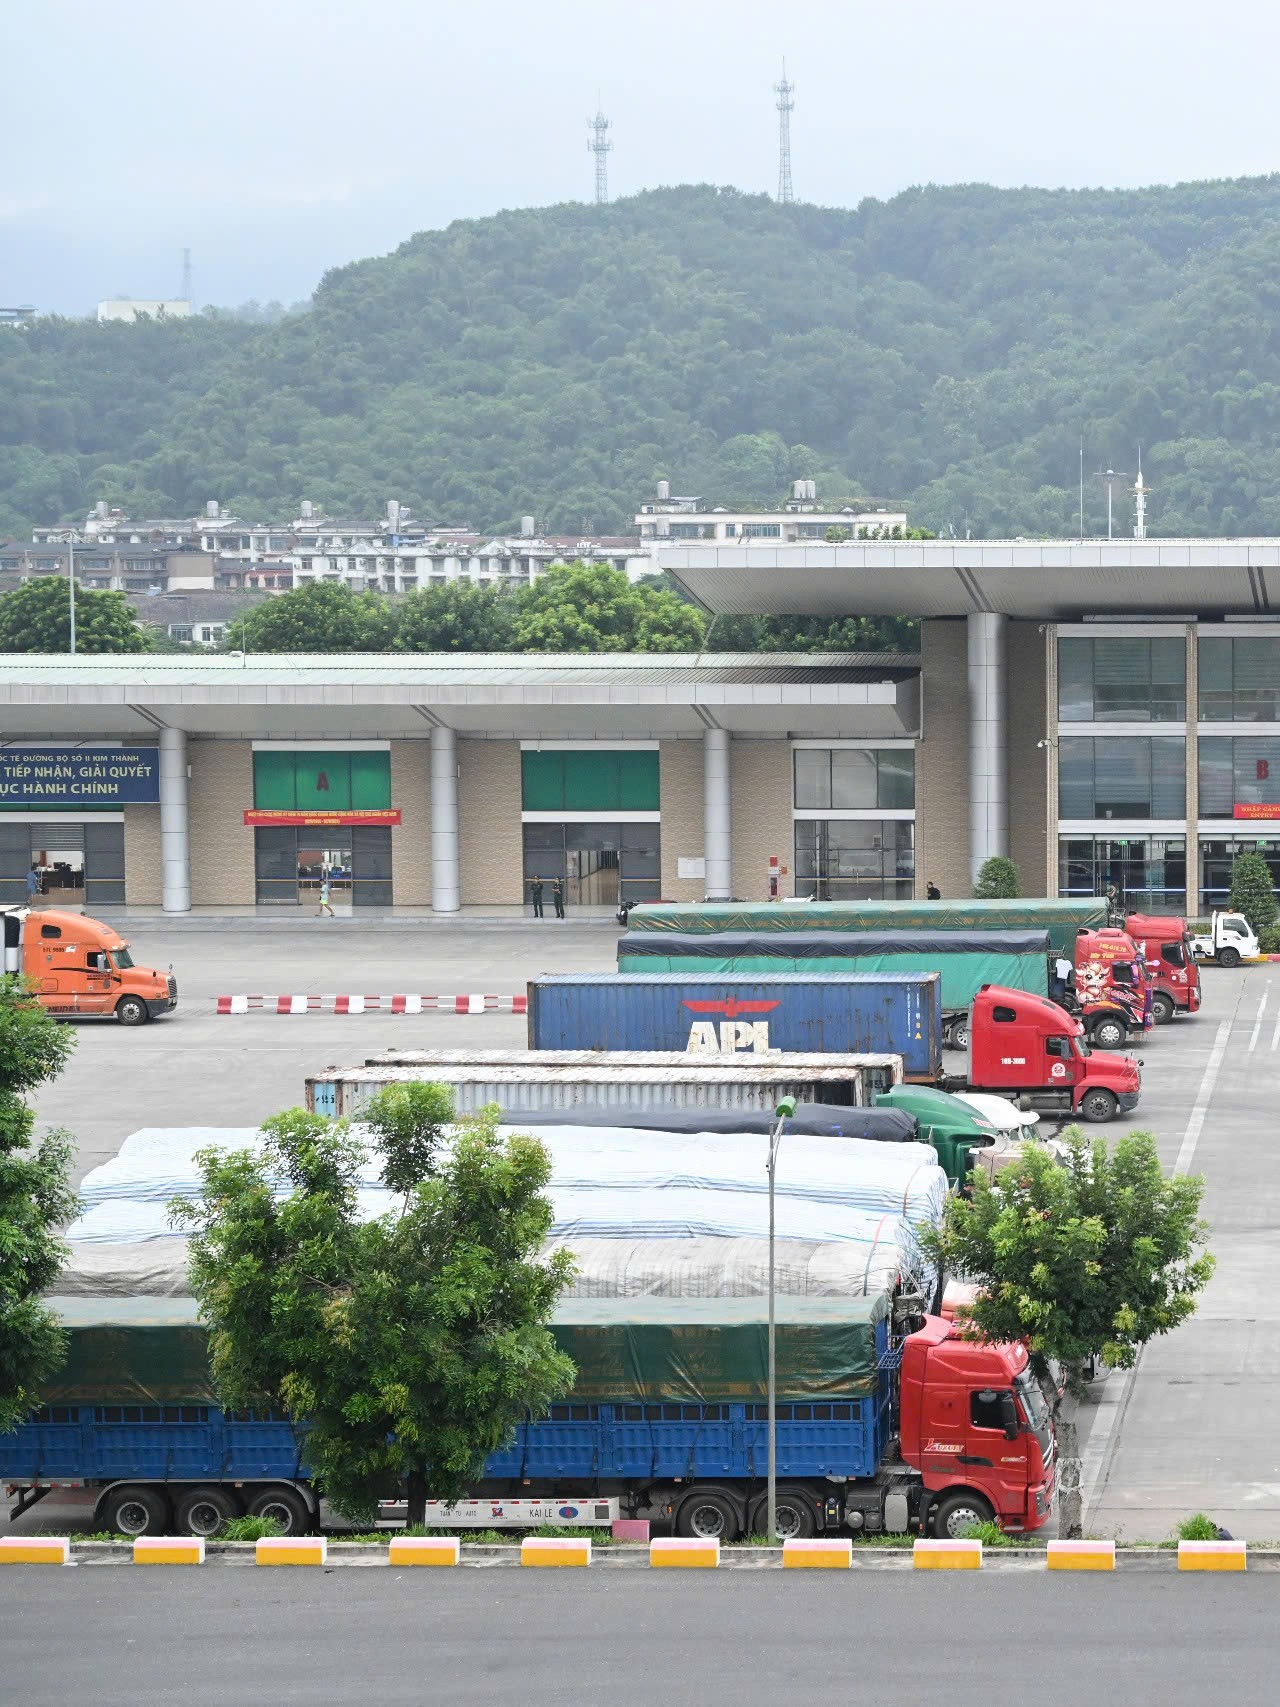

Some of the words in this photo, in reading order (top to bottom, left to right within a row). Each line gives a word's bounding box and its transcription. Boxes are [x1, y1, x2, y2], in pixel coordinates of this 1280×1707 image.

[10, 753, 20, 762] TẾ
[23, 753, 54, 762] ĐƯỜNG
[57, 754, 68, 763] BỘ
[71, 753, 82, 762] SỐ
[111, 753, 139, 762] THÀNH
[4, 763, 31, 778] TIẾP
[34, 764, 76, 780] NHẬN,
[79, 763, 106, 778] GIẢI
[110, 762, 152, 778] QUYẾT
[1257, 759, 1269, 780] B
[23, 781, 67, 794] HÀNH
[70, 781, 119, 794] CHÍNH
[316, 772, 329, 791] A
[686, 1021, 781, 1053] APL
[529, 1508, 542, 1518] KAI
[544, 1508, 553, 1518] LE
